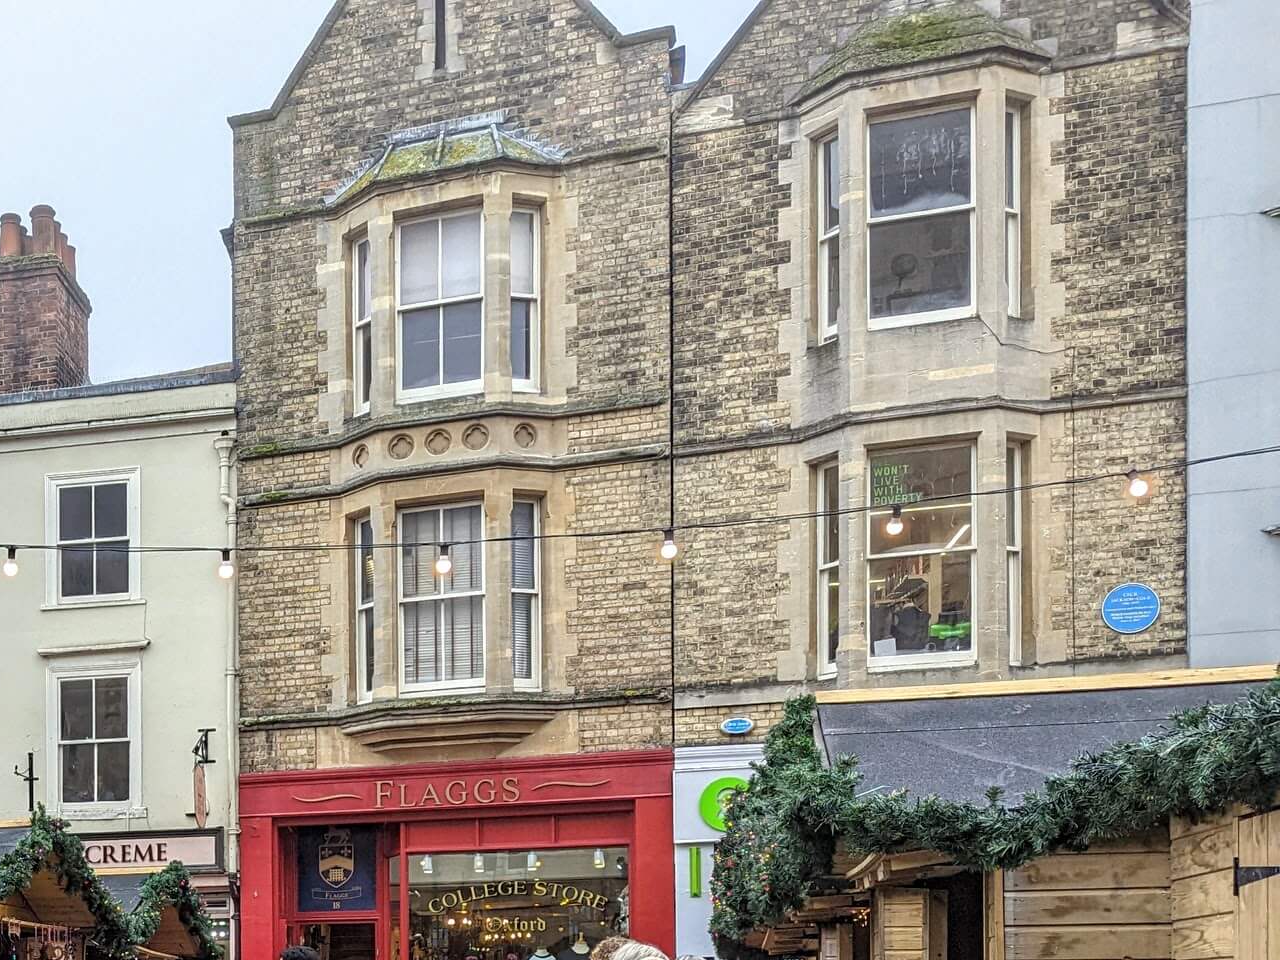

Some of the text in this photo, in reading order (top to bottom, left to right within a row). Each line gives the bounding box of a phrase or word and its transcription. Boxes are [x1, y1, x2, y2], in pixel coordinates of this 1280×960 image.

[873, 464, 910, 477] WON'T
[873, 475, 900, 487] LIVE
[873, 485, 903, 497] WITH
[874, 492, 923, 505] POVERTY
[374, 777, 521, 808] FLAGGS
[84, 843, 168, 864] CREME
[428, 880, 608, 913] COLLEGE STORE
[486, 917, 546, 932] Oxford
